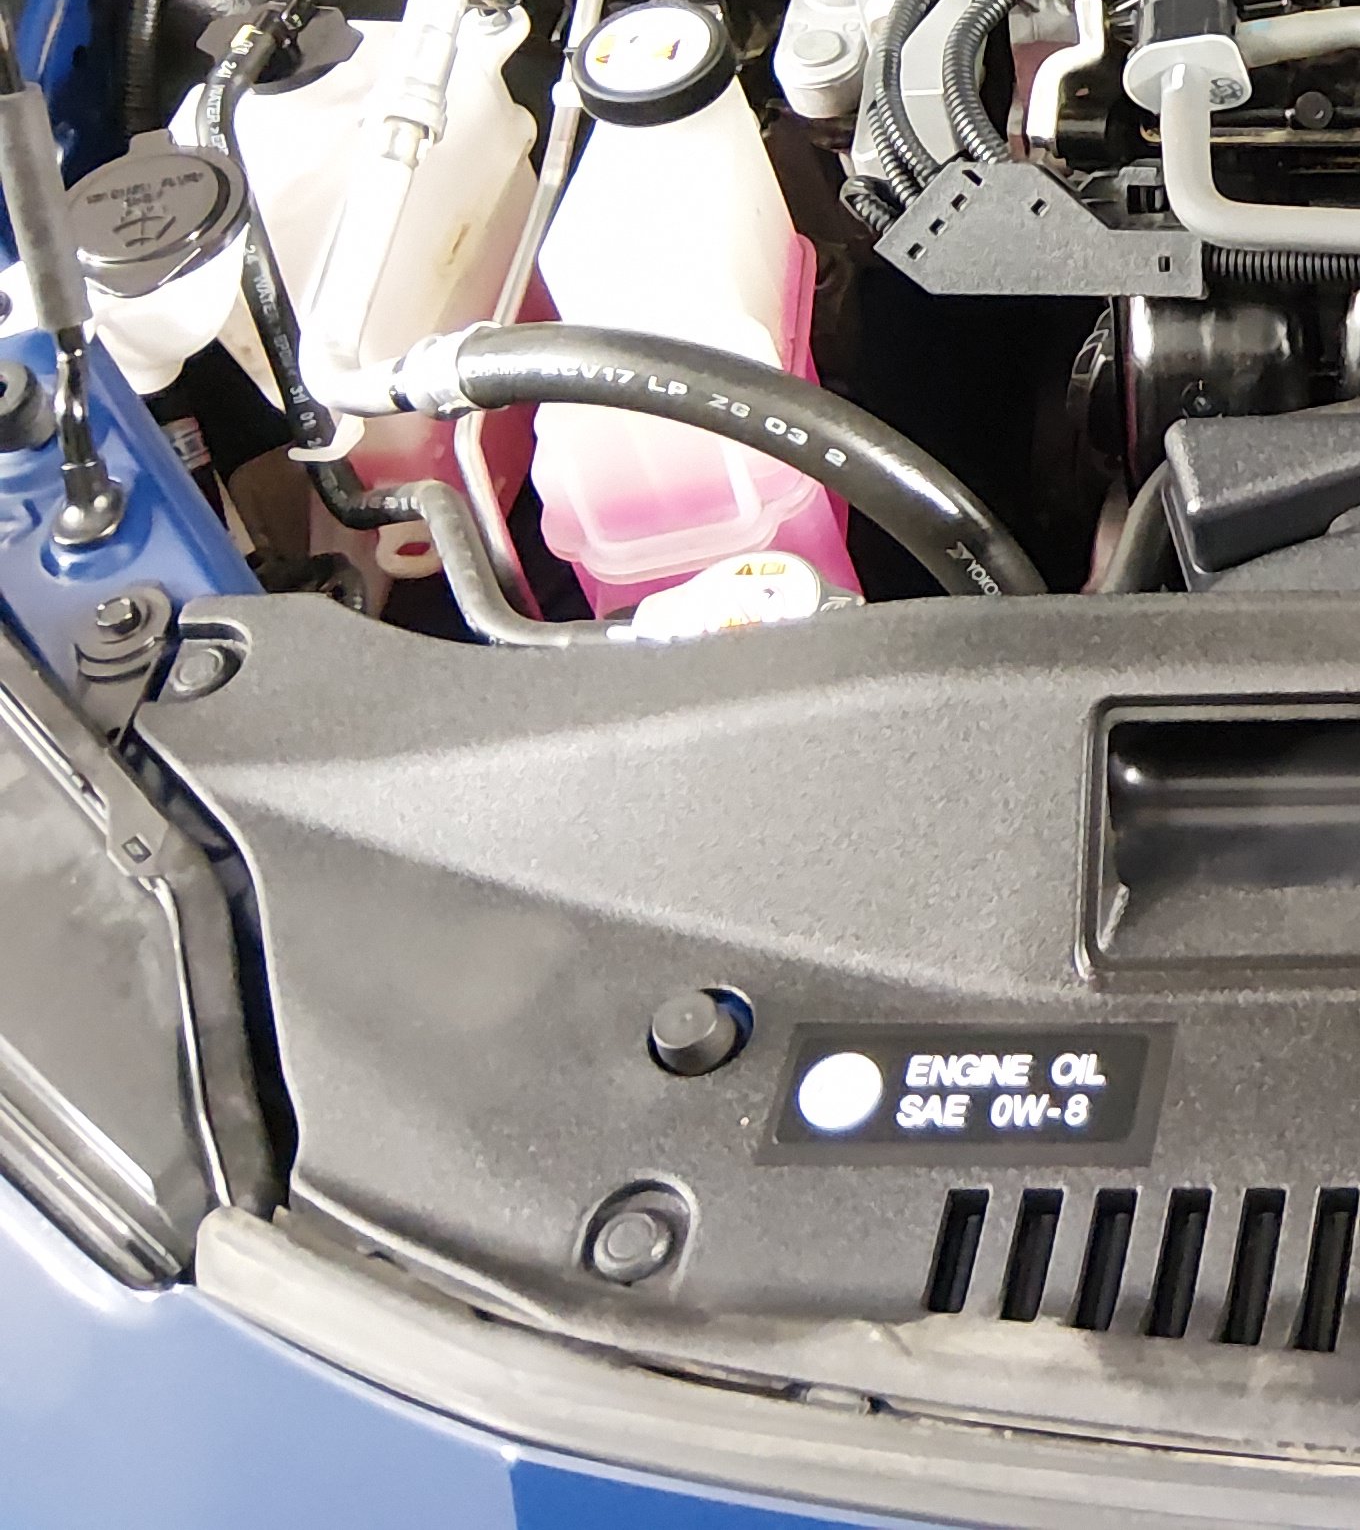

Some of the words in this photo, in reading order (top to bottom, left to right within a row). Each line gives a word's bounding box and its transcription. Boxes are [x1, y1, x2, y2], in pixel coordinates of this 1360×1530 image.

[647, 374, 688, 396] LP
[966, 559, 1001, 596] YOKO
[905, 1053, 1033, 1088] ENGINE
[1050, 1053, 1107, 1087] OIL
[895, 1094, 970, 1129] SAE
[989, 1094, 1090, 1128] 0W-8
